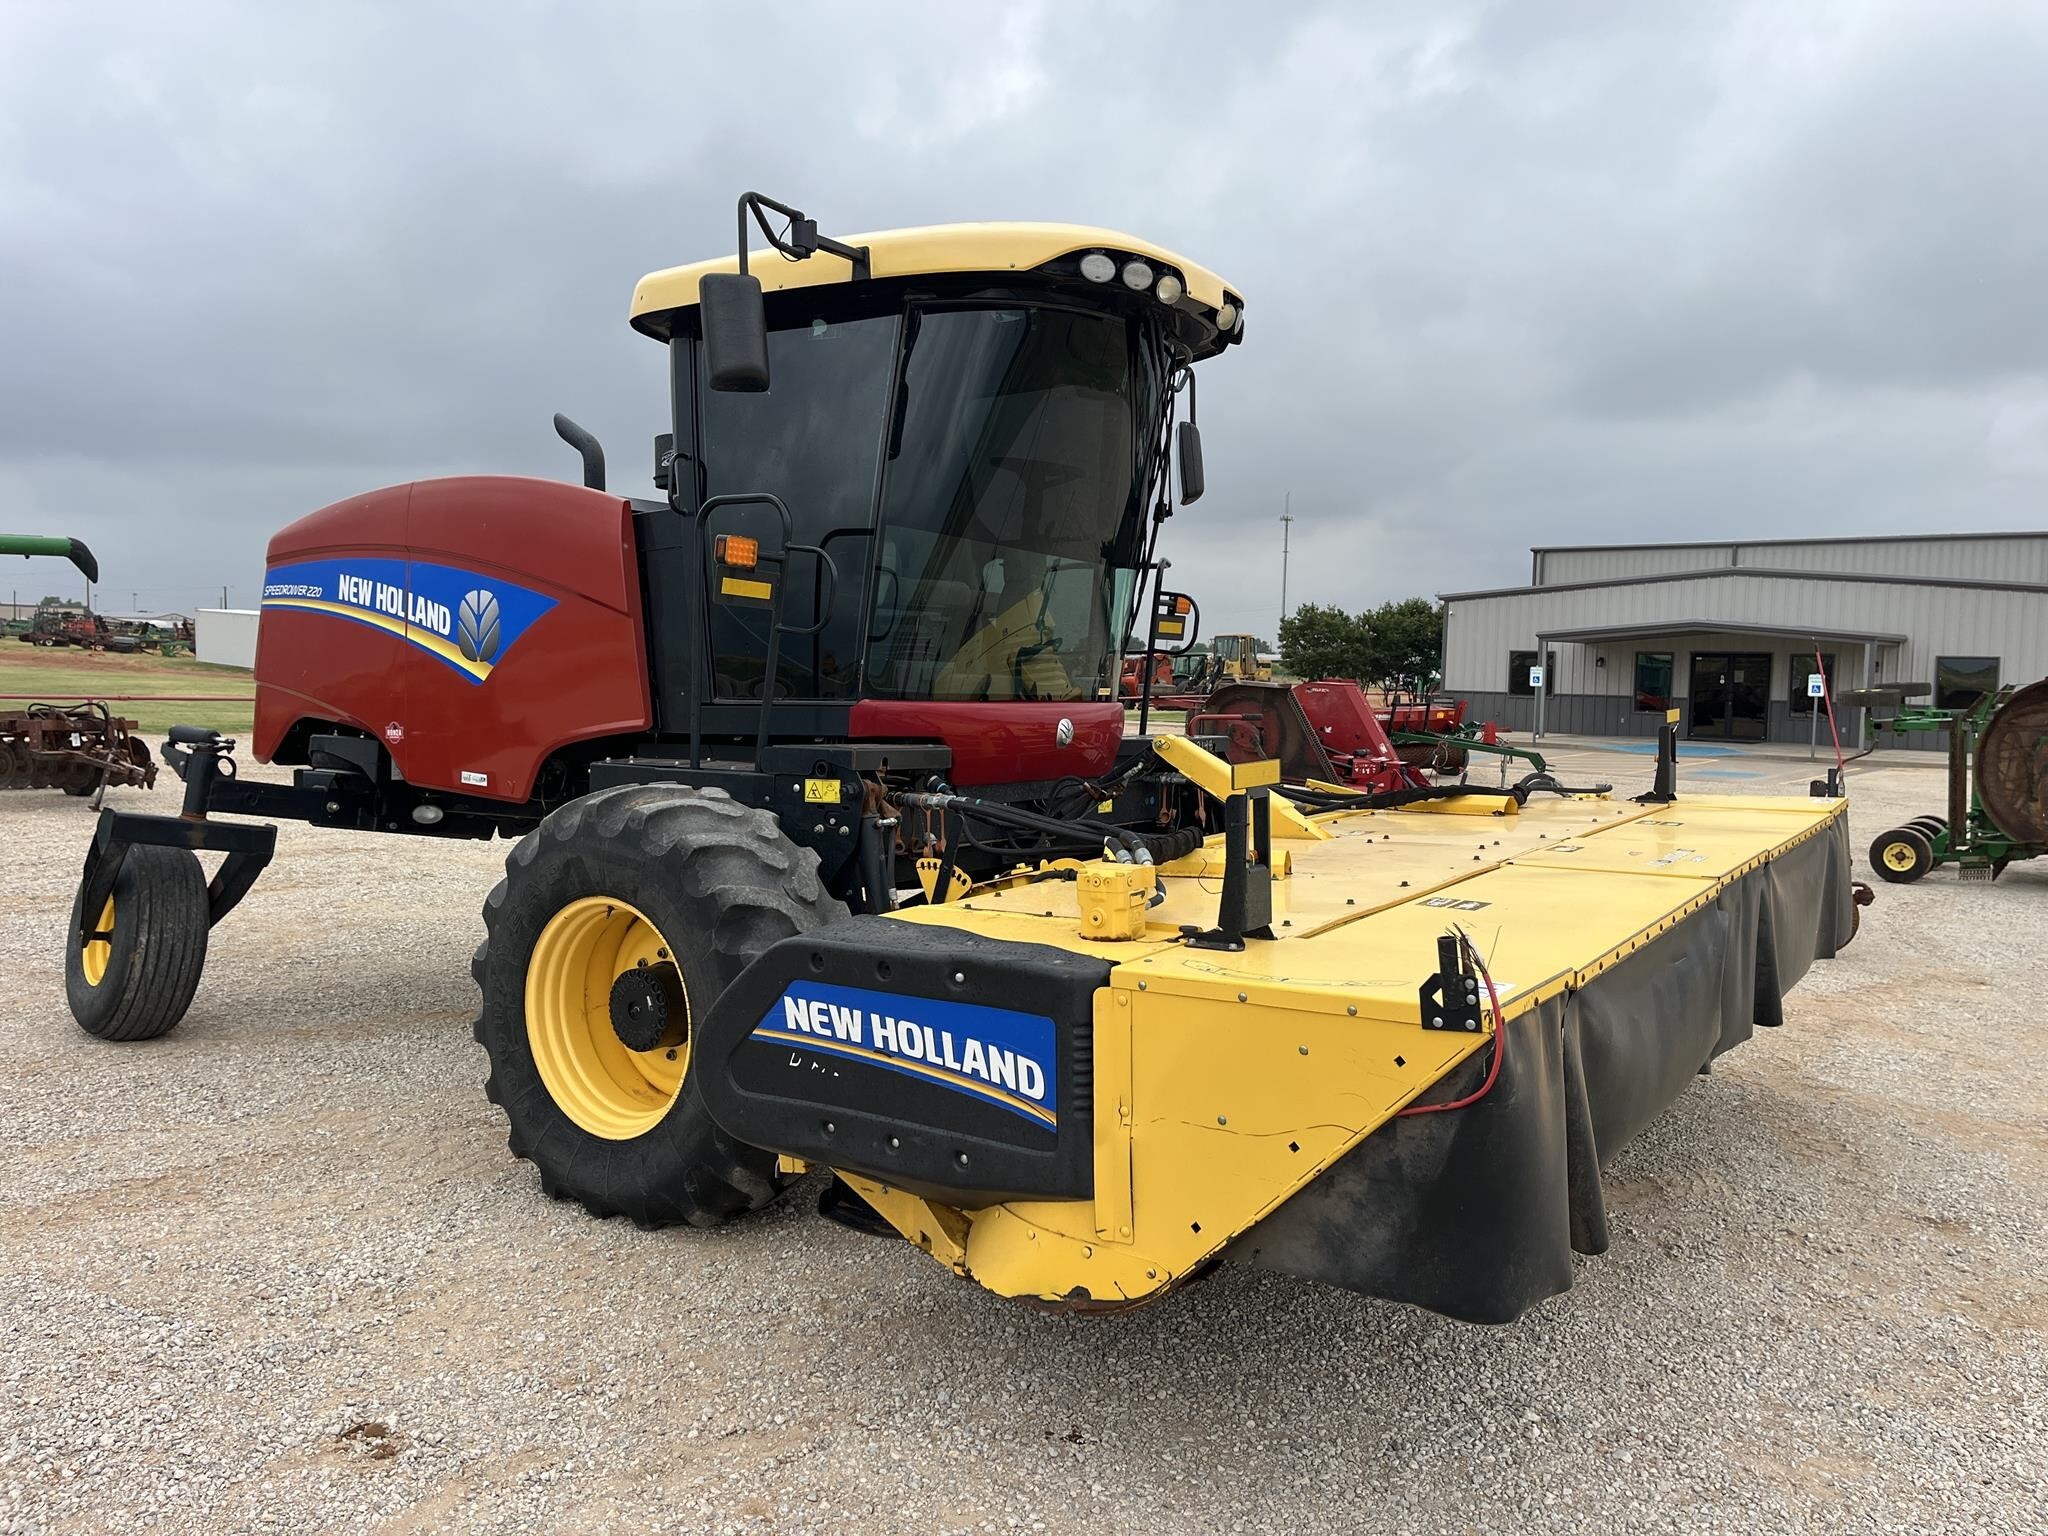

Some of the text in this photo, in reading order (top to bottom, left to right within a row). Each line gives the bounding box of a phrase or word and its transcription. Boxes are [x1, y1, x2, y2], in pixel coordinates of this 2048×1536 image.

[264, 585, 323, 598] SPEEDROWER 220
[338, 574, 451, 636] NEW HOLLAND
[783, 995, 1045, 1100] NEW HOLLAND
